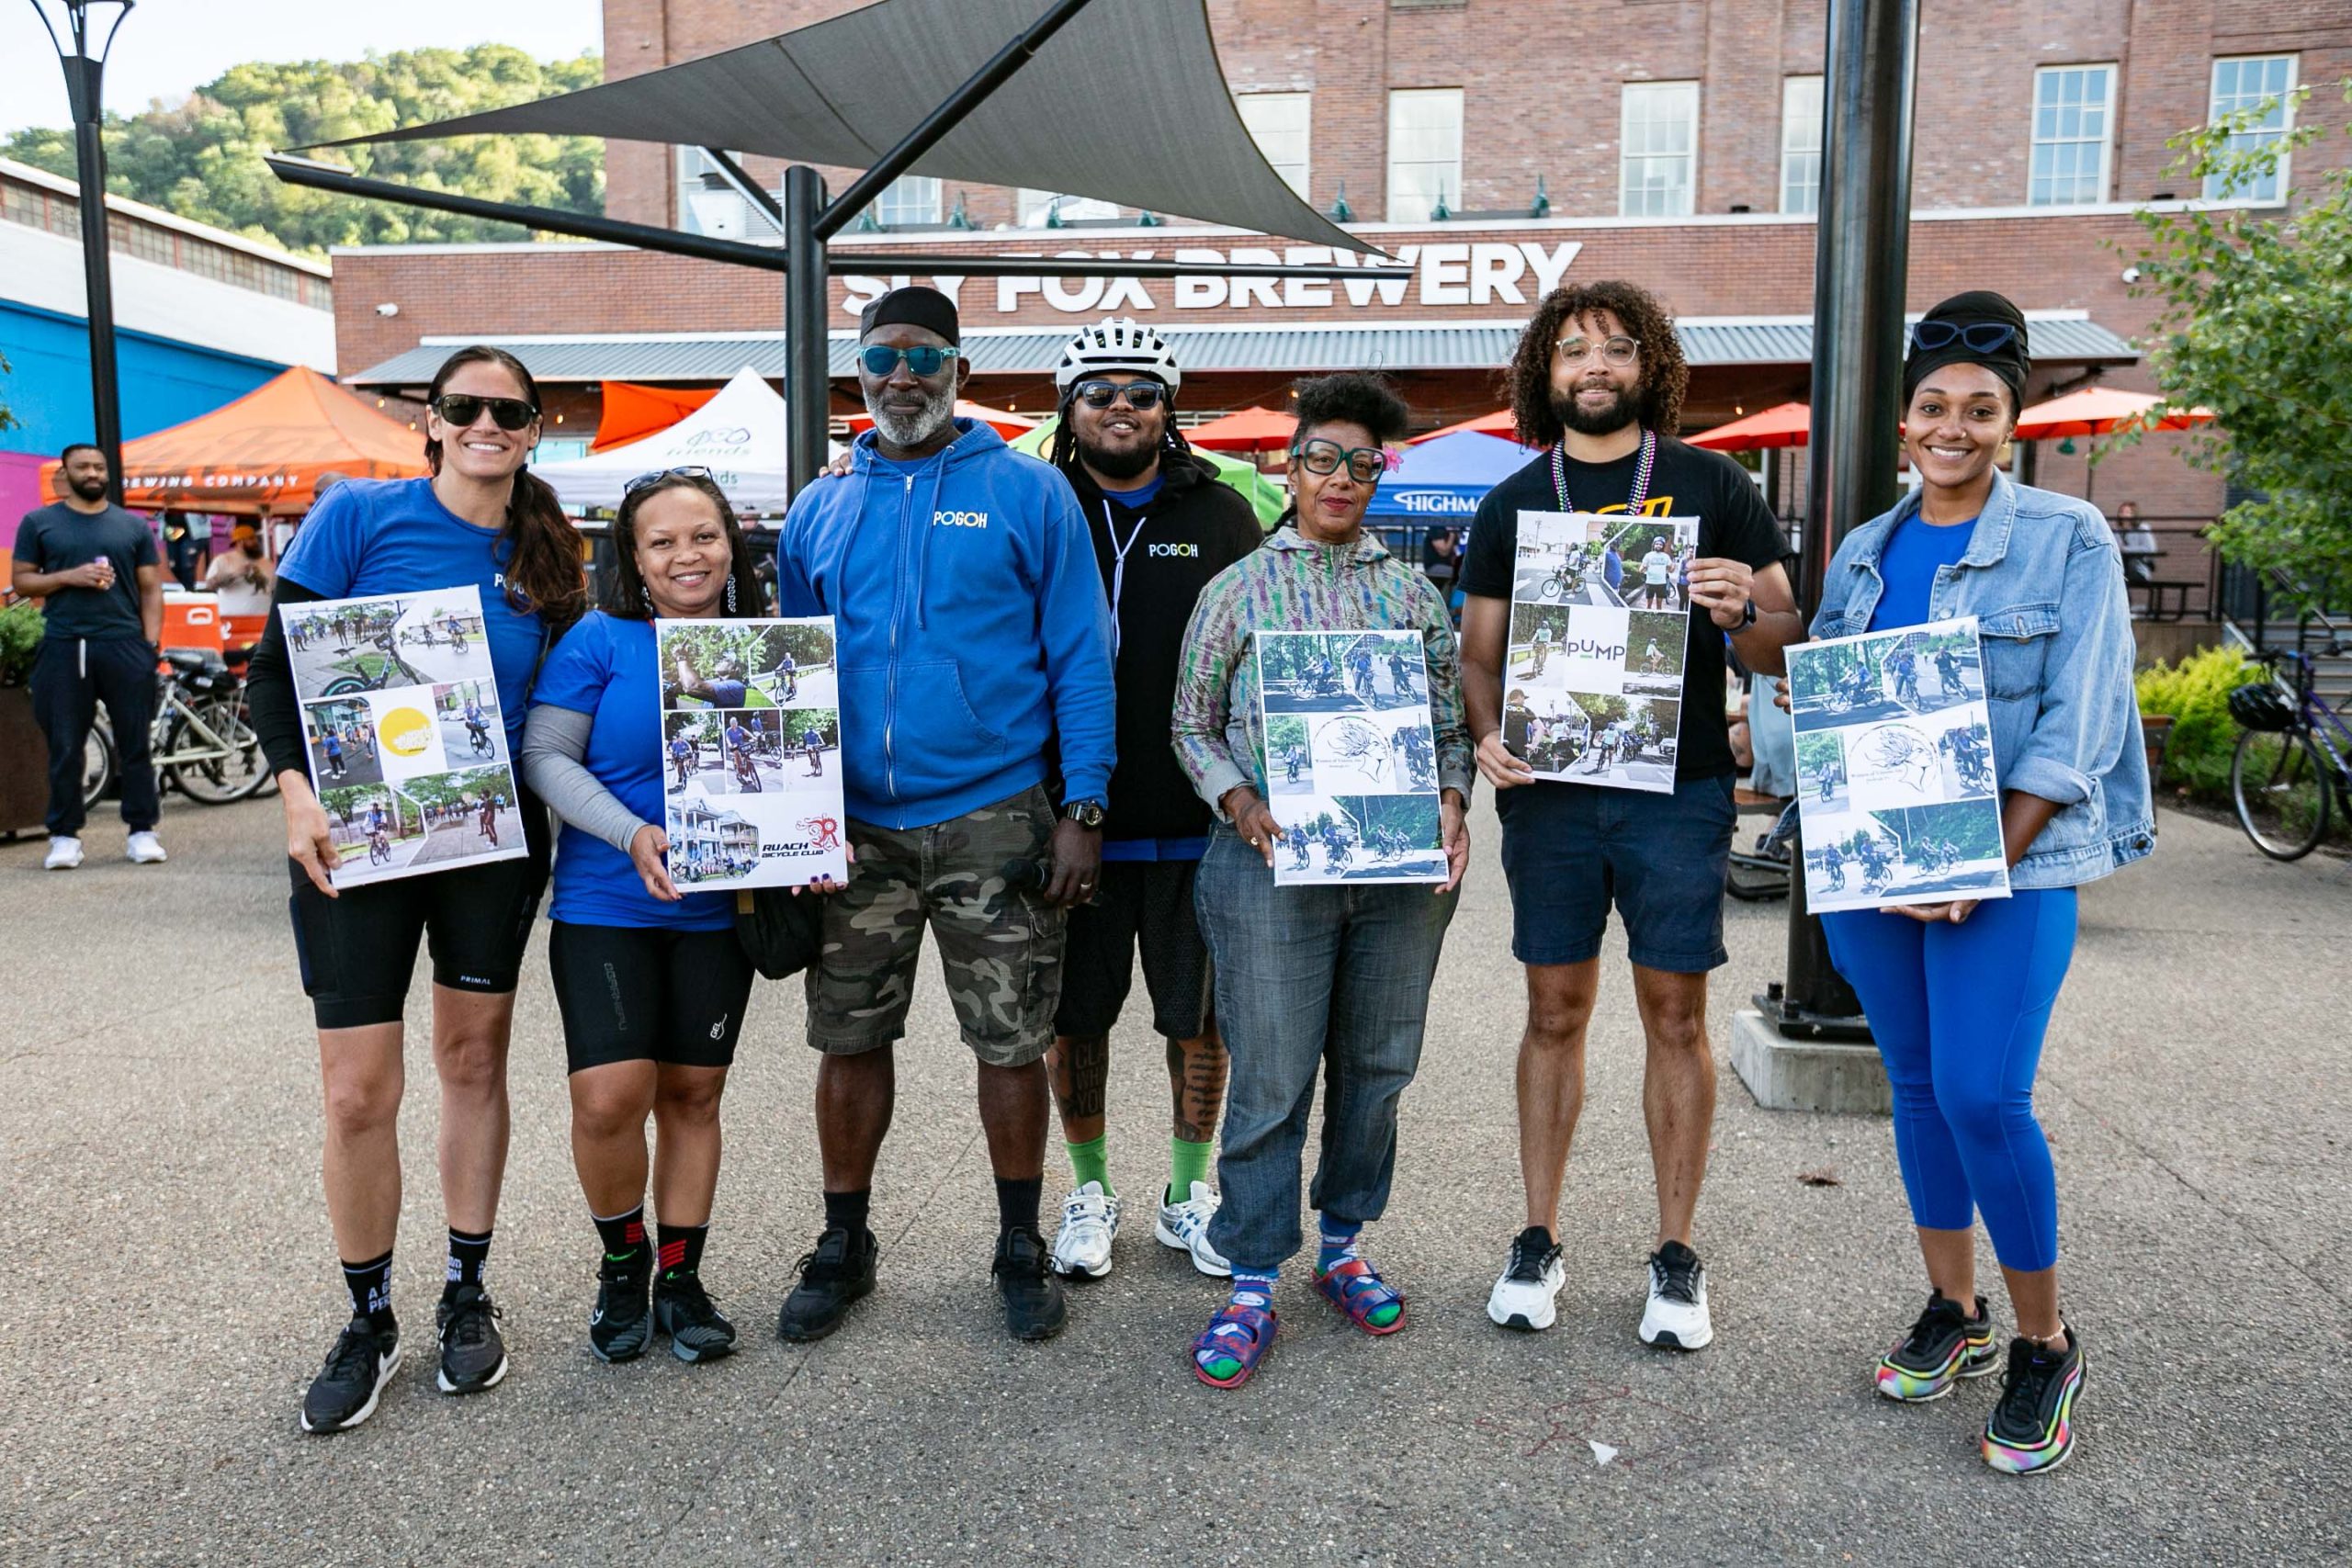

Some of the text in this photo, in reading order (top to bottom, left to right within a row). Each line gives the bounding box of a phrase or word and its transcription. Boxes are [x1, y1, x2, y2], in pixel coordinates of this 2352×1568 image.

[1175, 242, 1583, 309] BREWERY
[204, 474, 299, 488] COMPANY
[933, 511, 988, 529] POGOH
[1148, 543, 1199, 558] POGOH
[1566, 638, 1625, 660] PUMP
[762, 842, 808, 852] RUACH
